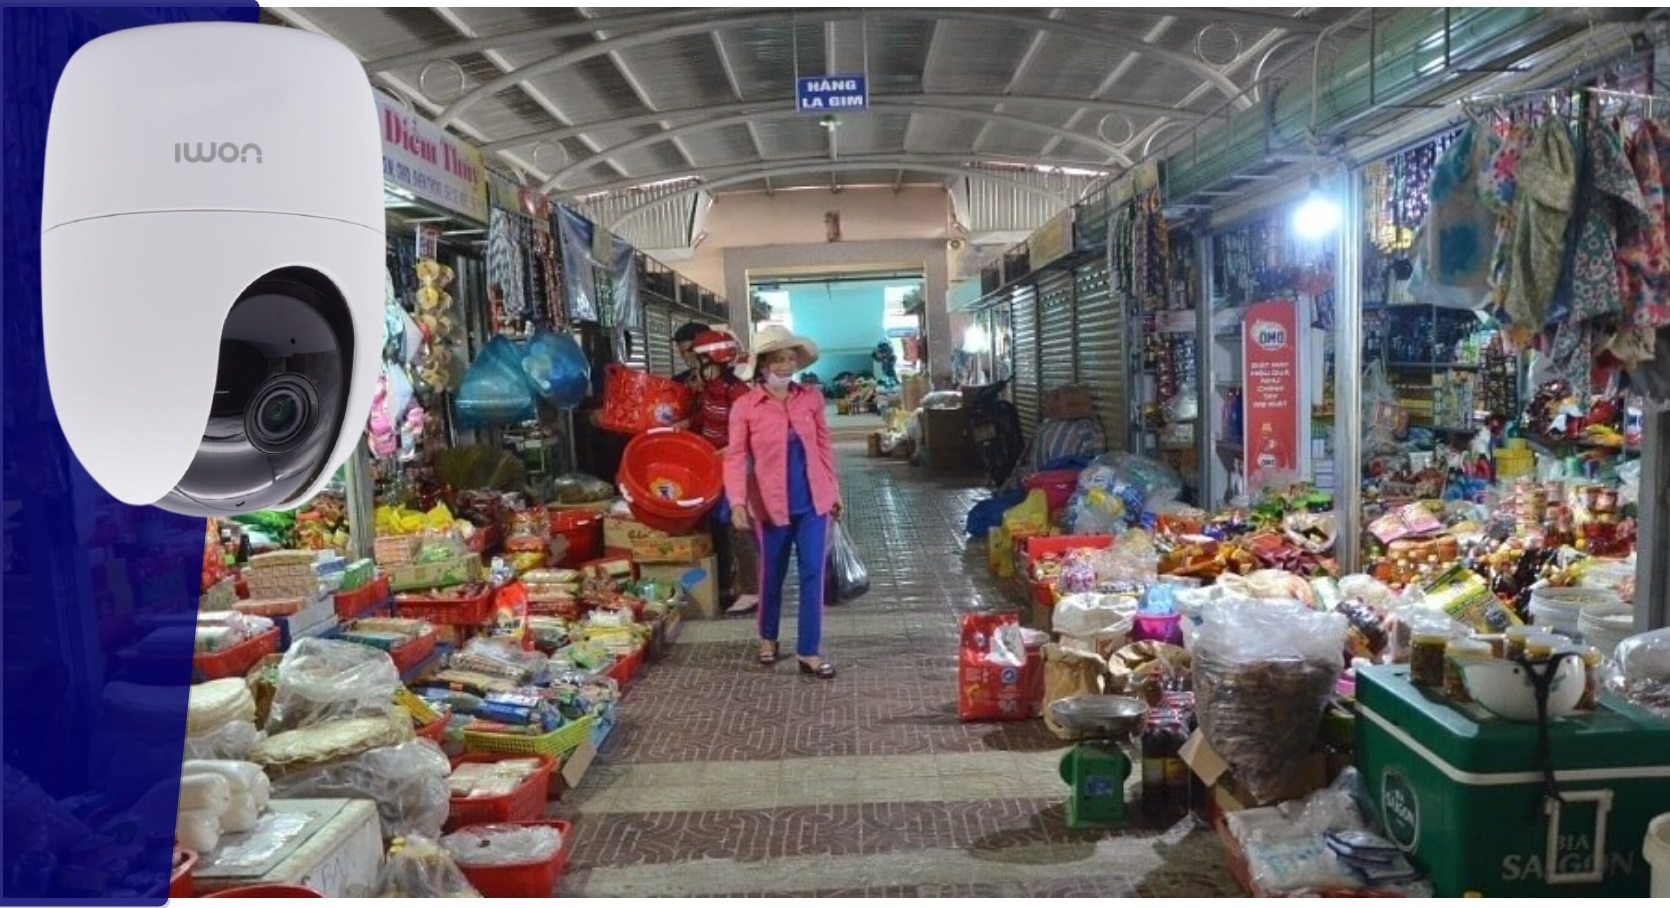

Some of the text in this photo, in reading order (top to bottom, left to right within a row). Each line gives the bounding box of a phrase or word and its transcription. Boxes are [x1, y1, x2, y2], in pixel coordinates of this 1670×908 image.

[802, 96, 825, 108] LA
[1260, 331, 1284, 344] OMO
[1501, 850, 1635, 880] SAGON
